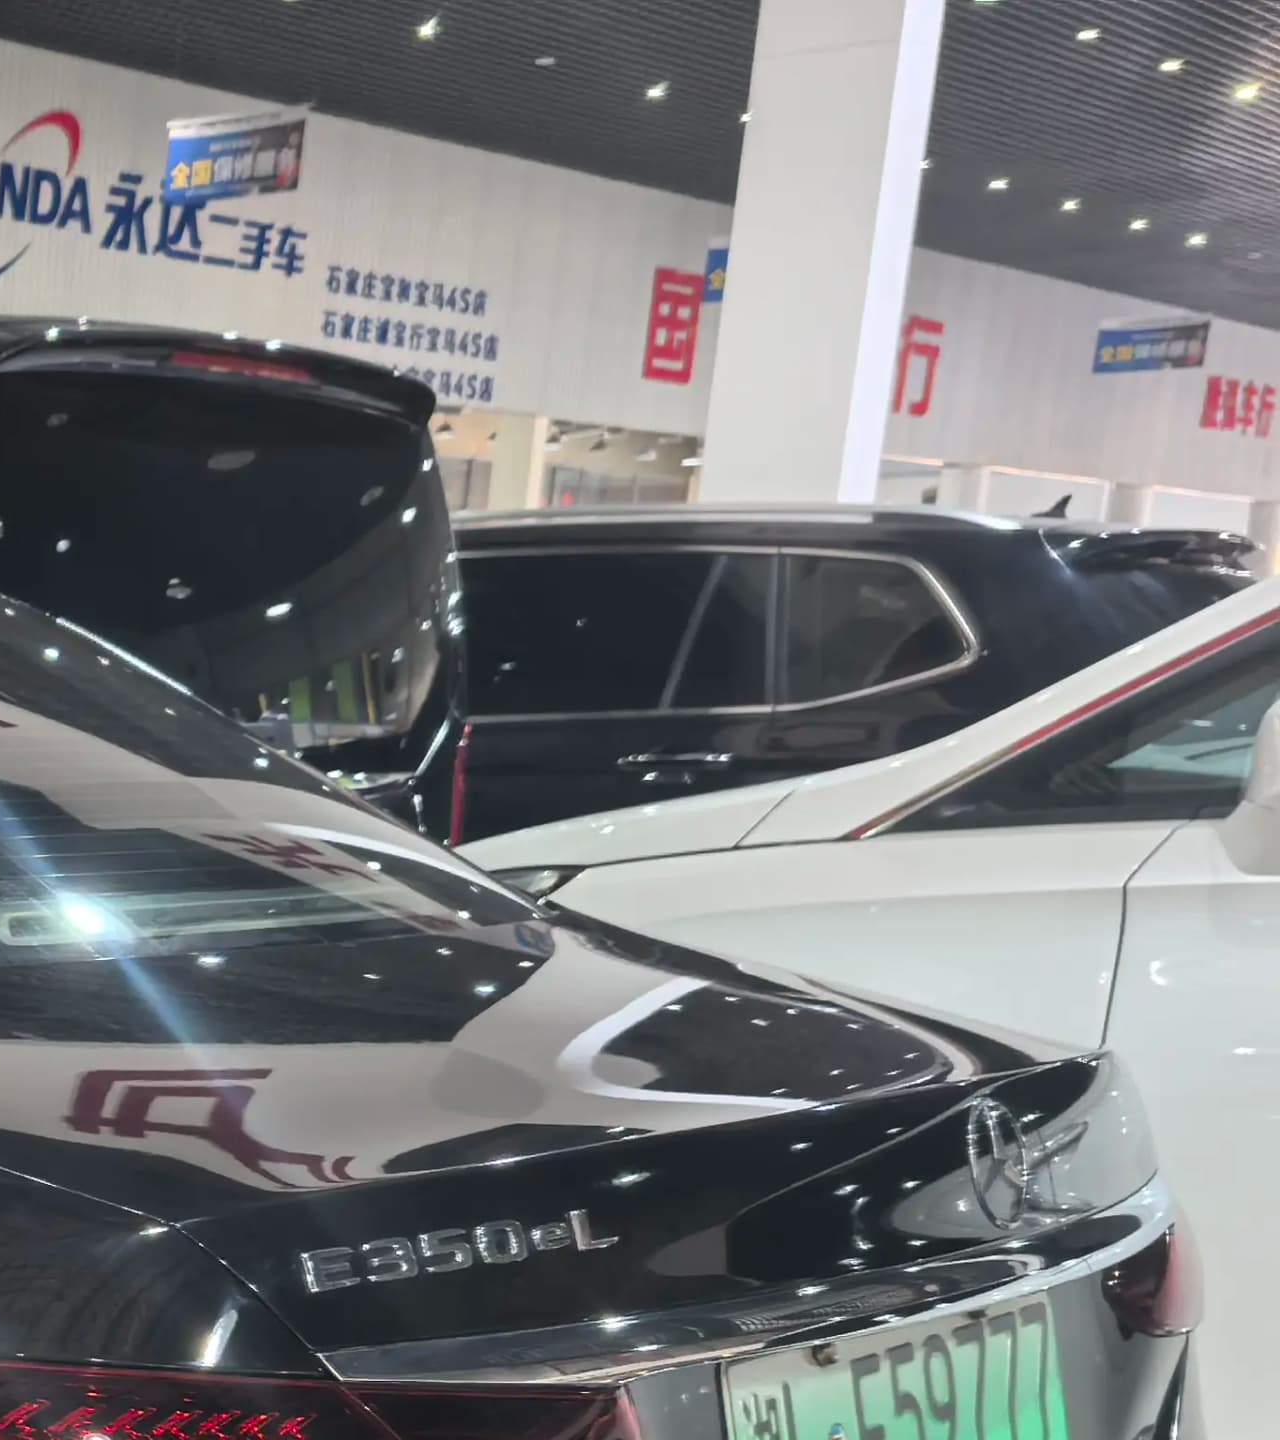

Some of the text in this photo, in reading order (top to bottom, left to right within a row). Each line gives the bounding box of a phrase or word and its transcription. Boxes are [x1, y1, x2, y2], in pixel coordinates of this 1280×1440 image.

[100, 171, 308, 279] 永达二手车
